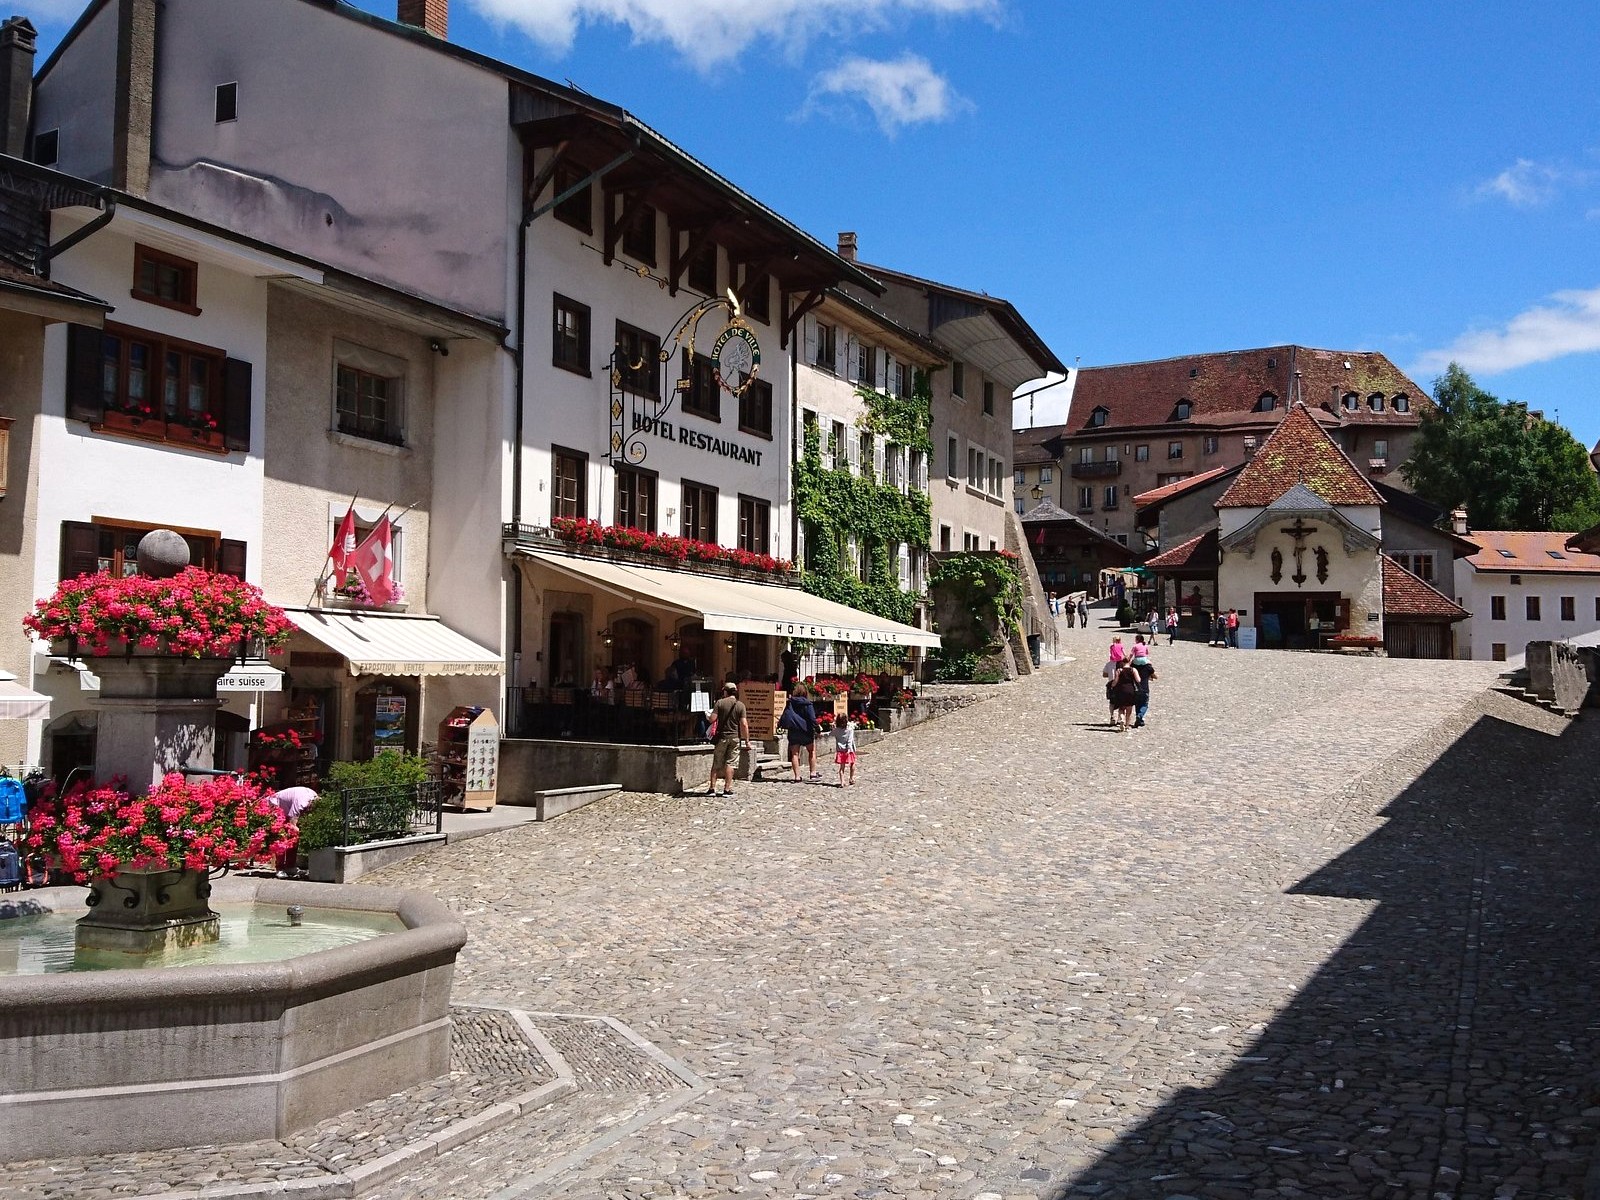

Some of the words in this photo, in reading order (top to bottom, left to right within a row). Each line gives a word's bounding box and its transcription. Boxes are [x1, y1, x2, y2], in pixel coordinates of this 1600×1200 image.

[711, 333, 731, 360] HOTEL
[731, 328, 745, 337] DE
[745, 331, 760, 357] VILLE
[632, 412, 676, 442] HOTEL
[679, 426, 763, 467] RESTAURANT
[776, 623, 825, 637] HOTEL
[837, 630, 850, 639] de
[860, 631, 897, 643] VILLE
[360, 662, 397, 672] EXPOSITION
[403, 663, 425, 672] VENTES
[238, 675, 266, 687] suisse
